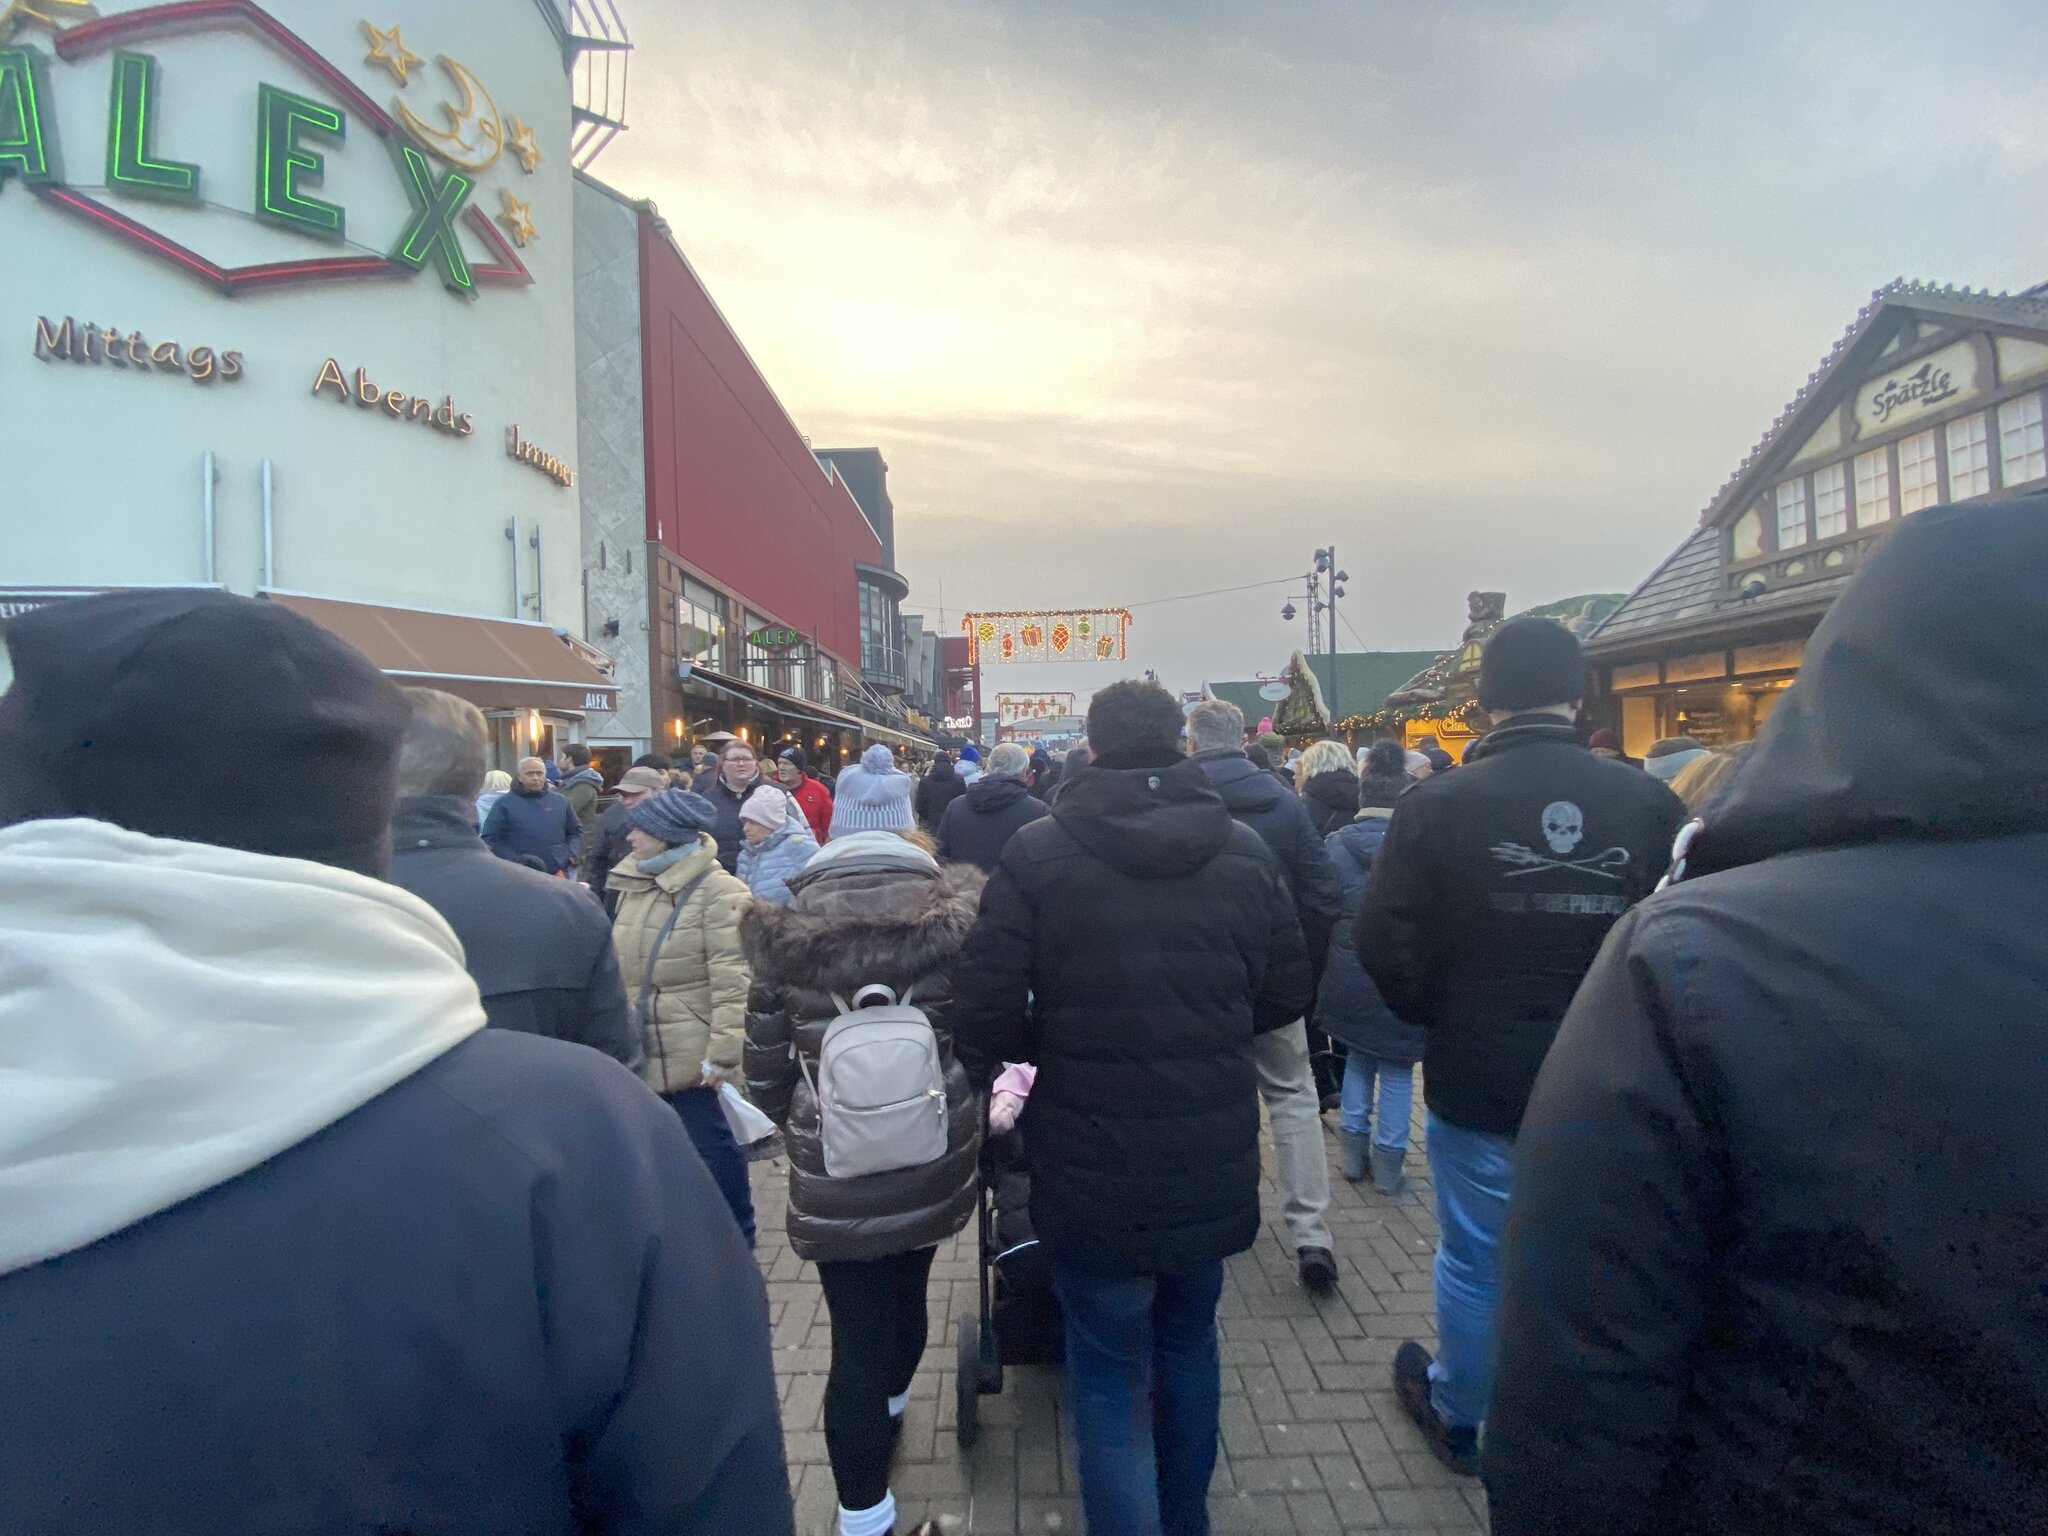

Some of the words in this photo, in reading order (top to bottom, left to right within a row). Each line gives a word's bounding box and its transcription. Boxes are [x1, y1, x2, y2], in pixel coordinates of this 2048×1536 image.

[0, 43, 478, 299] ALEX
[33, 315, 244, 384] Mittags
[312, 357, 474, 437] Abends
[752, 629, 798, 646] ALEX
